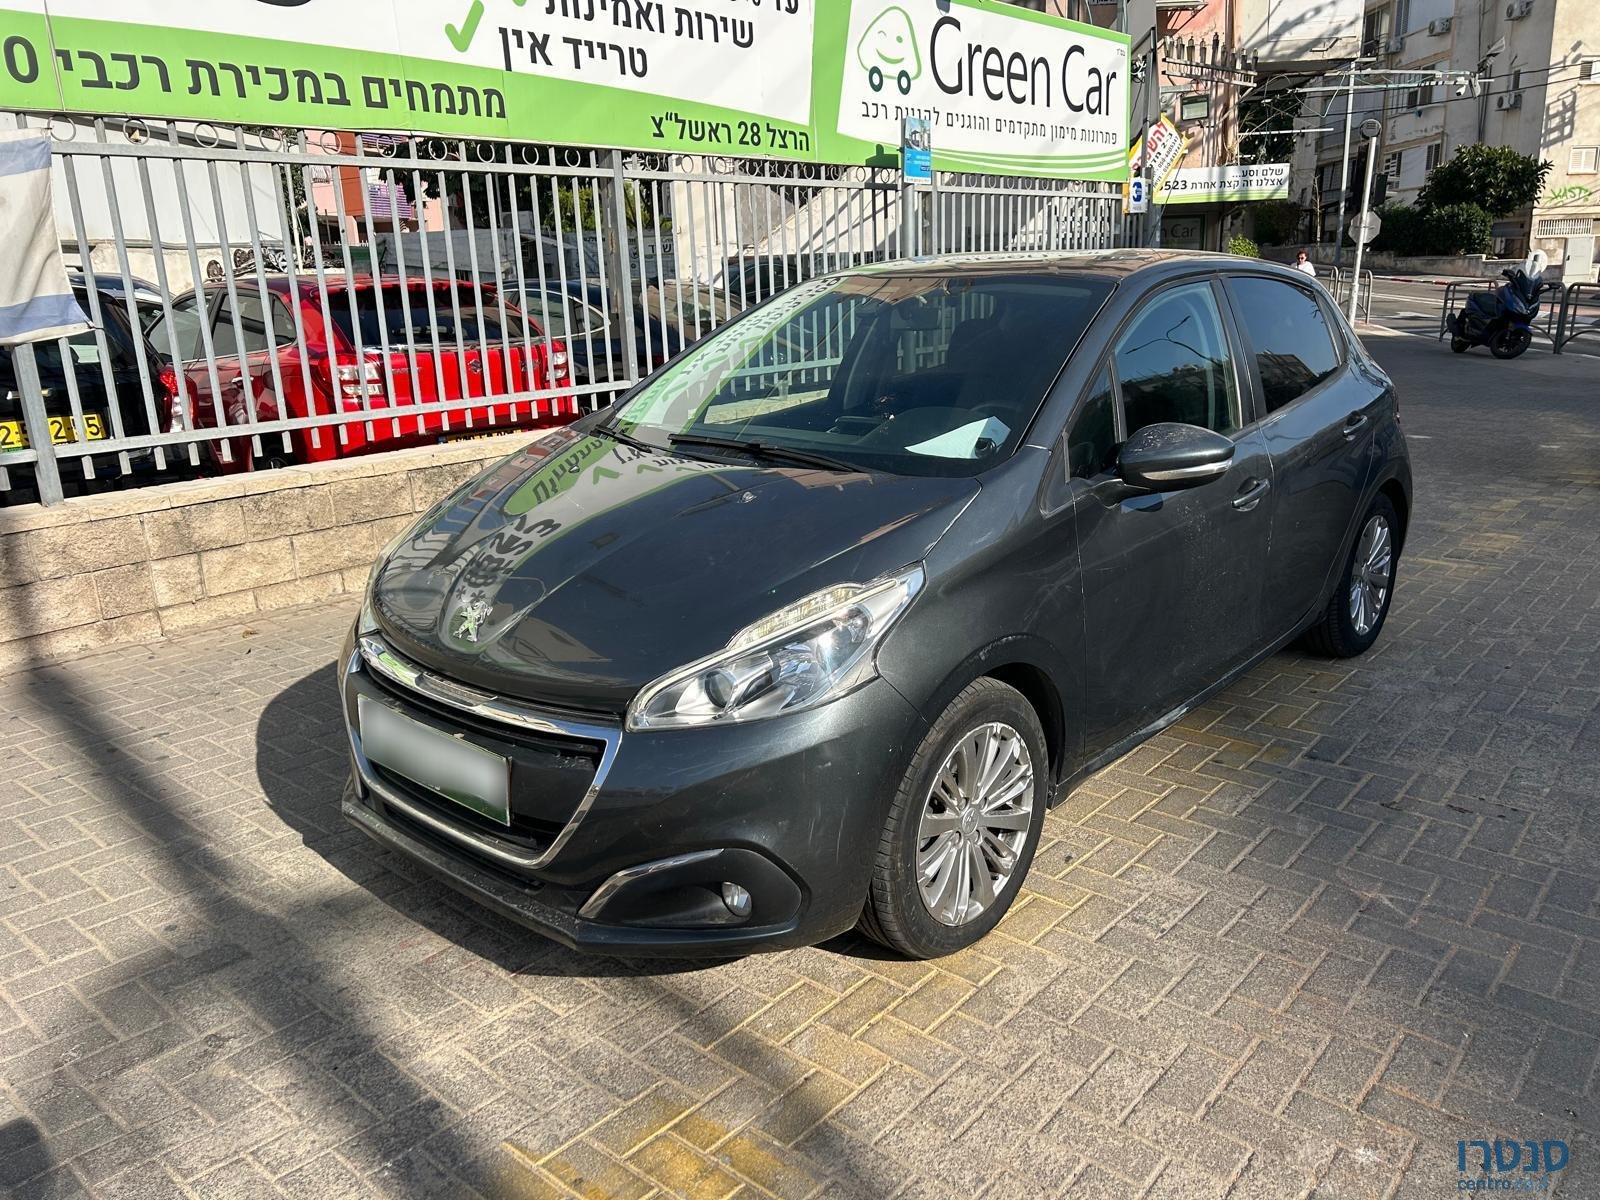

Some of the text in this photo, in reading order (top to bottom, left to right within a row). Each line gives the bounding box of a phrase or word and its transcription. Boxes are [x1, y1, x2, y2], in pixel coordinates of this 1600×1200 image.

[674, 6, 754, 49] שירות
[498, 27, 648, 79] טרייד אין
[930, 15, 1117, 117] Green Car
[55, 48, 172, 94] רכבי
[184, 58, 351, 107] במכירת
[362, 75, 508, 119] מתמחים
[861, 100, 888, 120] רכב
[650, 112, 811, 152] הרצל 28 ראשל"צ
[946, 111, 990, 131] והוגנים
[995, 118, 1046, 140] מתקדמים
[1050, 124, 1077, 142] מימון
[1080, 128, 1117, 145] פתרונות
[1159, 177, 1283, 191] אצלנו זה קצת אחרת 523
[1261, 166, 1284, 178] שלם
